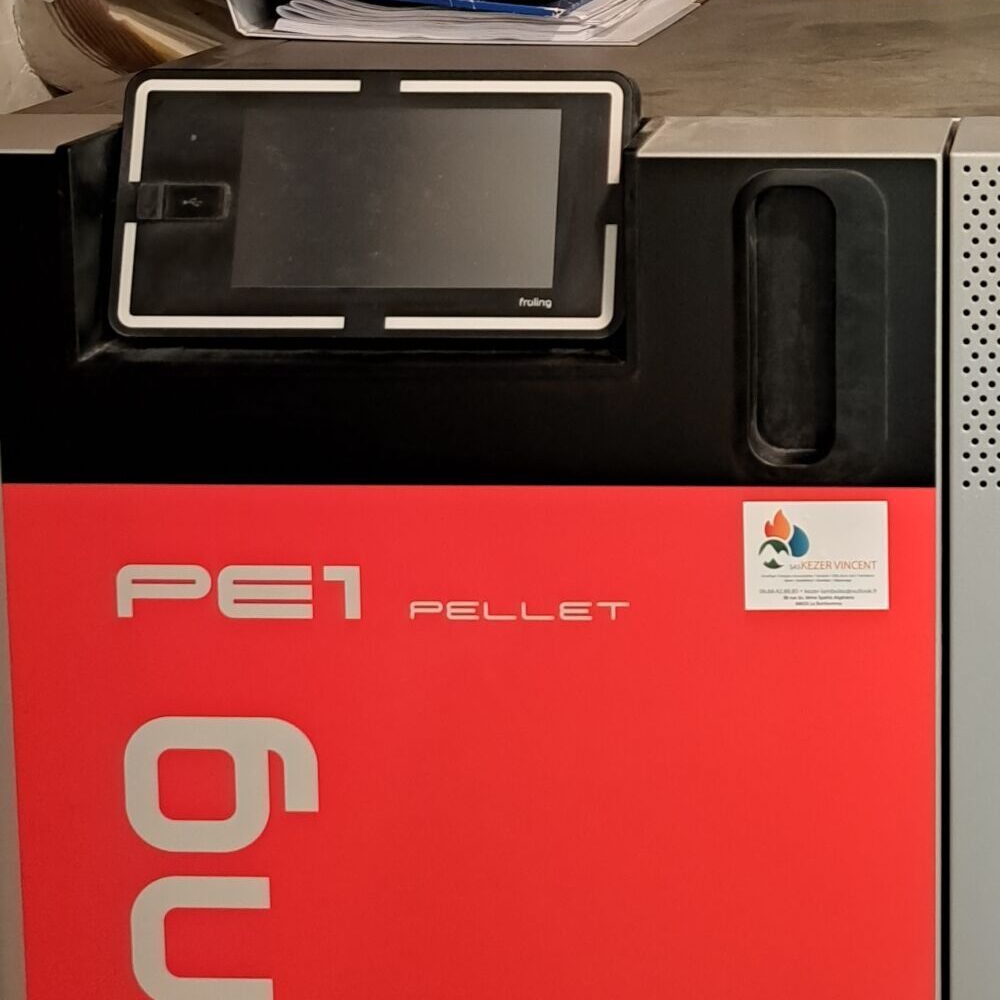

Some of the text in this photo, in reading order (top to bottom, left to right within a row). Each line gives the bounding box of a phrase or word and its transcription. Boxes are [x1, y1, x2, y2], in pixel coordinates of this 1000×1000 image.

[801, 560, 832, 570] KEZER
[834, 560, 877, 570] VINCENT
[116, 564, 360, 620] PE1
[409, 600, 630, 622] PELLET
